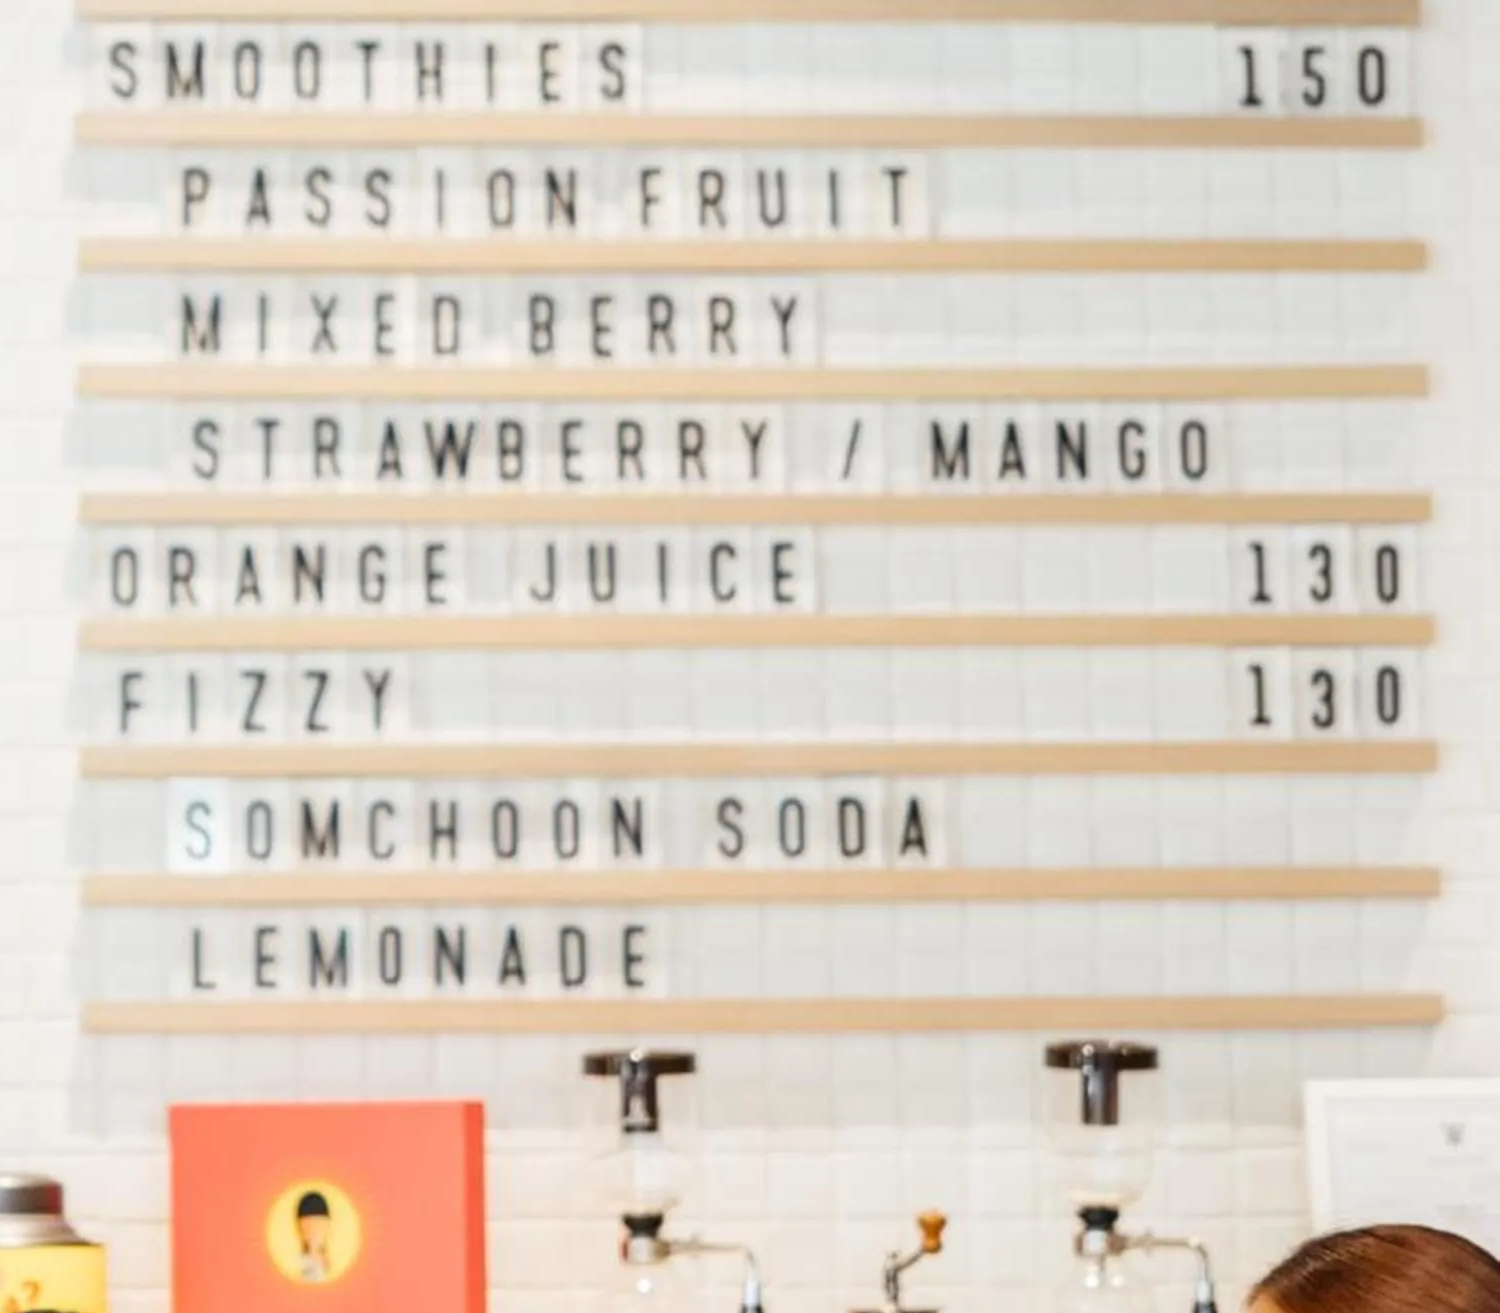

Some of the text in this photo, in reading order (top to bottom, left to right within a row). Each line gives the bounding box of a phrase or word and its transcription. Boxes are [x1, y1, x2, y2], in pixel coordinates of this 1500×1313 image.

[108, 38, 1387, 110] SMOOTHIES 150
[181, 165, 909, 230] PASSION FRUIT
[180, 291, 799, 360] MIXED BERRY
[191, 415, 1209, 485] STRAWBERRY / MANGO
[110, 540, 1401, 608] ORANGE JUICE 130
[119, 662, 1402, 735] FIZZY 130
[185, 795, 929, 862] SOMCHOON SODA
[191, 923, 646, 991] LEMONADE
